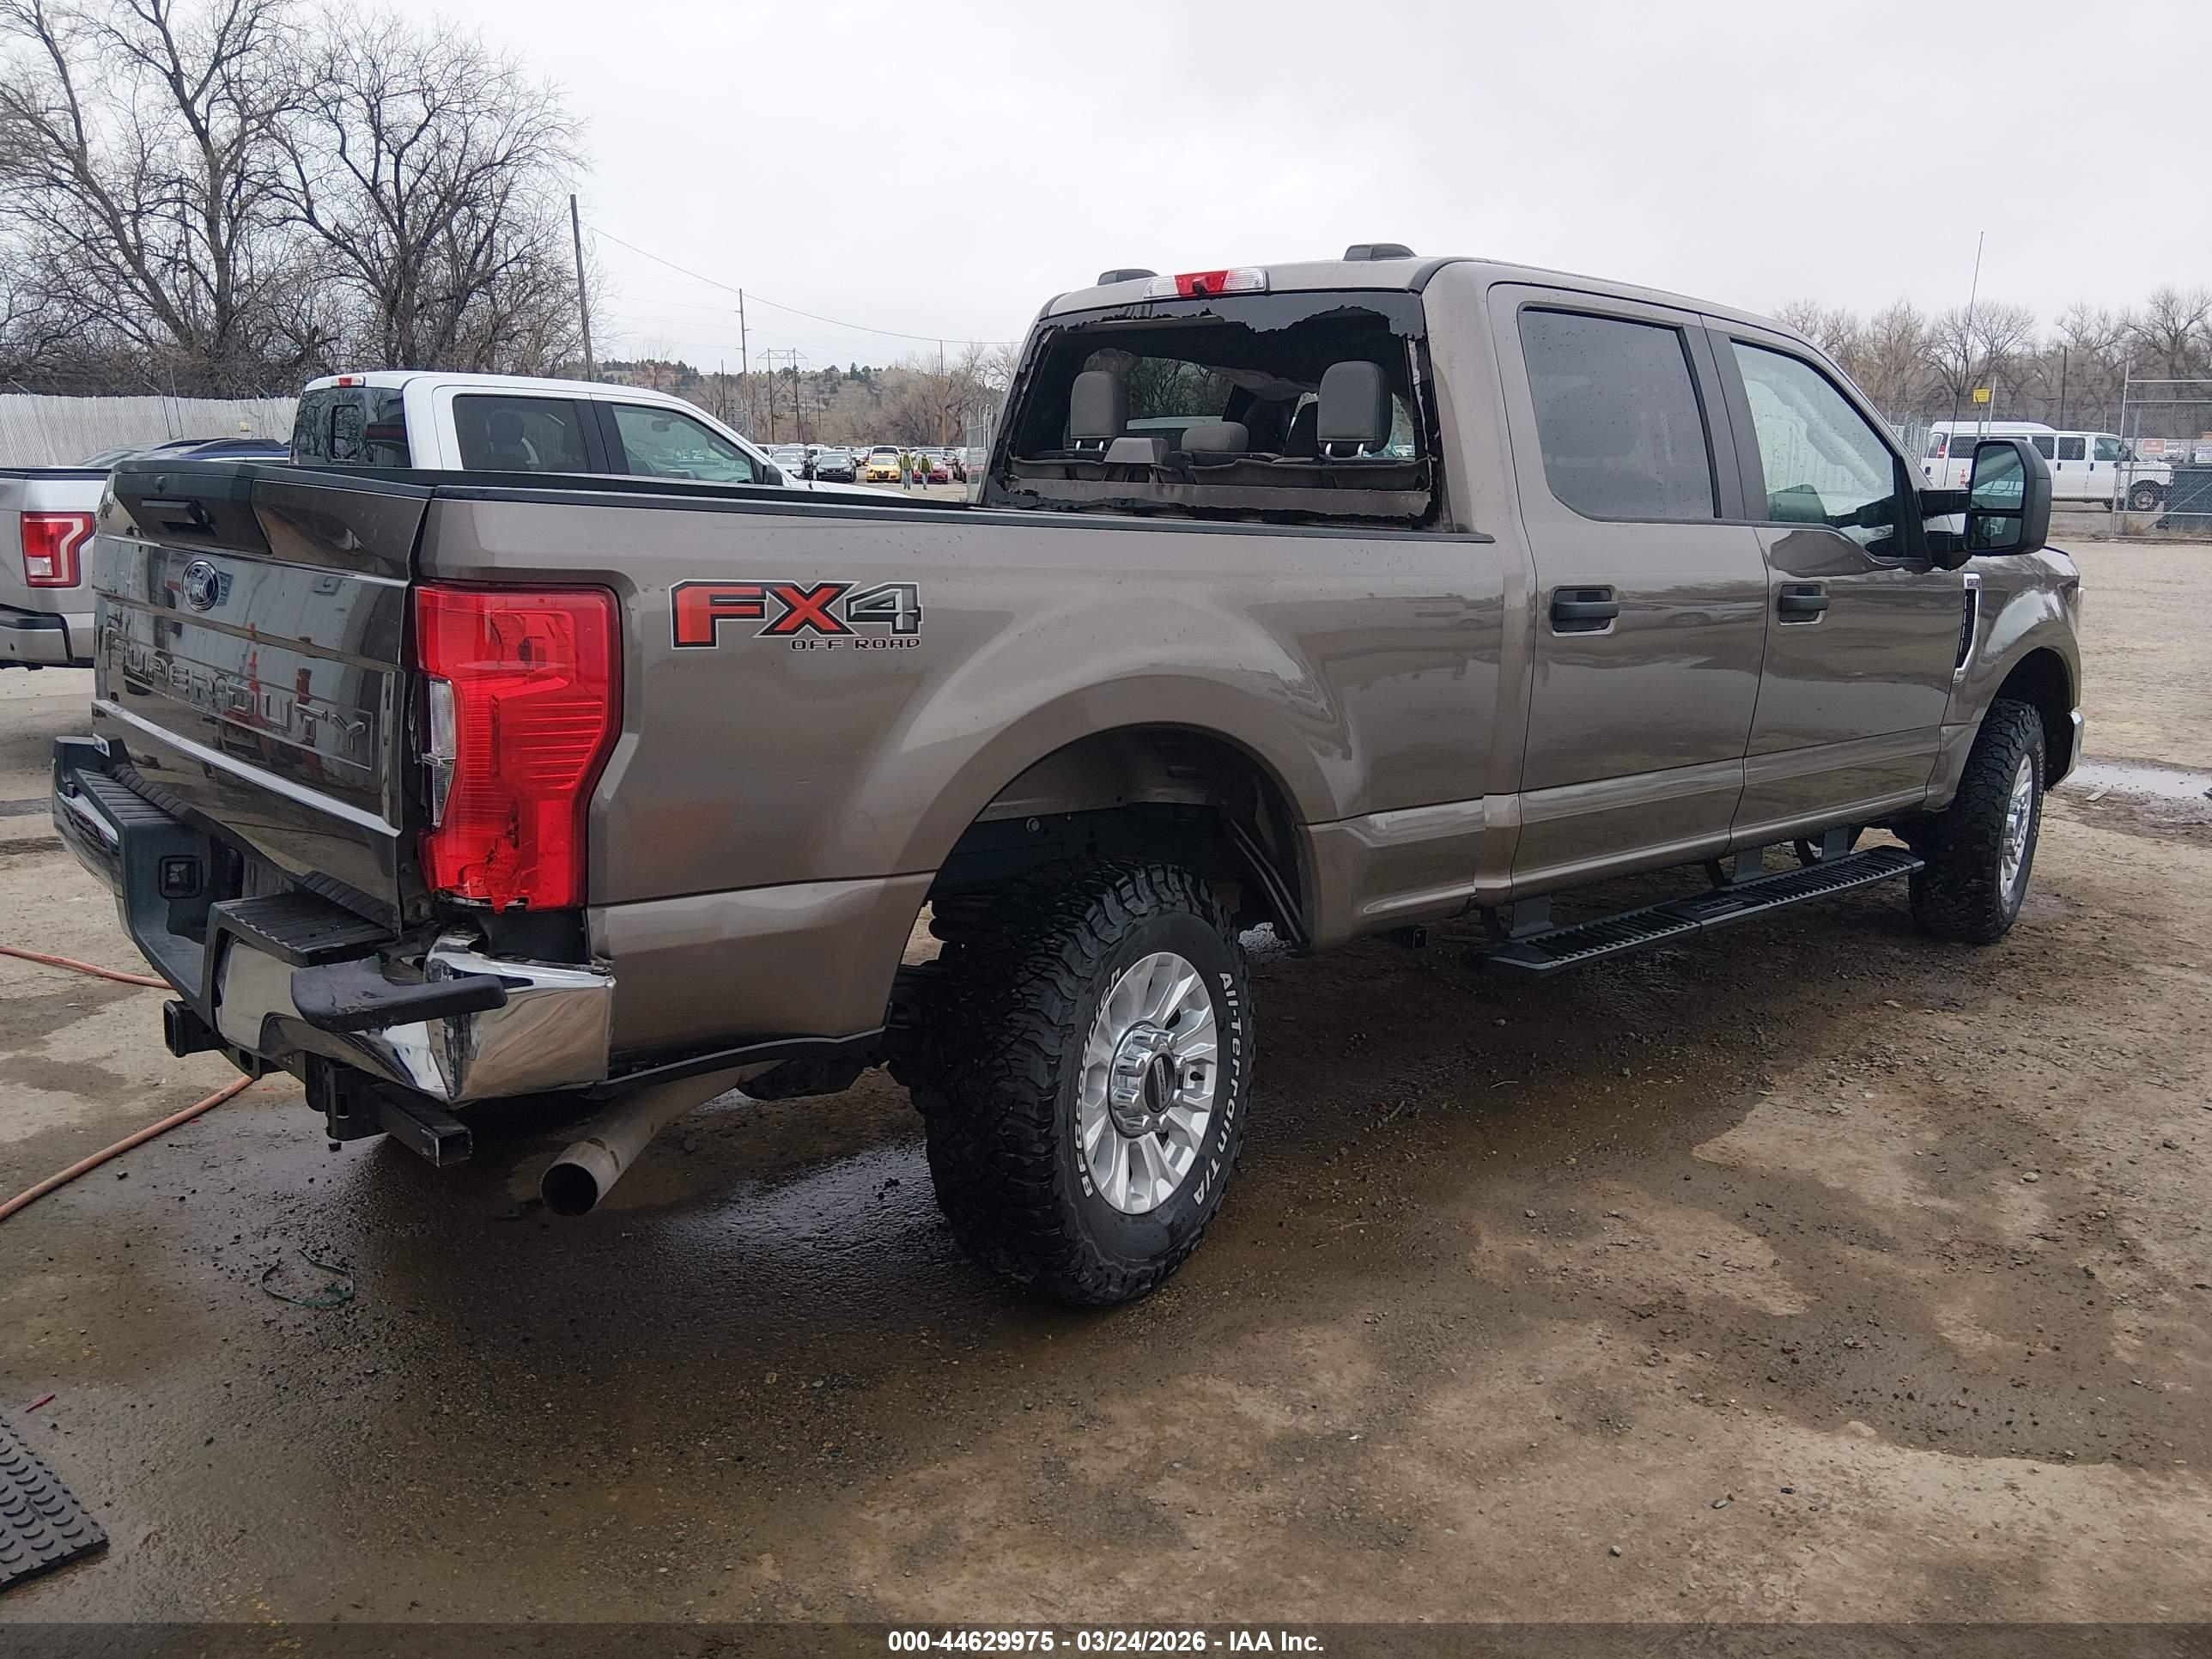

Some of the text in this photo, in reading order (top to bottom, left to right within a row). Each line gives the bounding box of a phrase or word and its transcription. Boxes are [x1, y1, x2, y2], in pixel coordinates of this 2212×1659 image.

[669, 578, 924, 651] FX4
[790, 637, 921, 652] OFF ROAD
[226, 682, 366, 755] DUTY
[1193, 972, 1243, 1206] All-Terrain T/A
